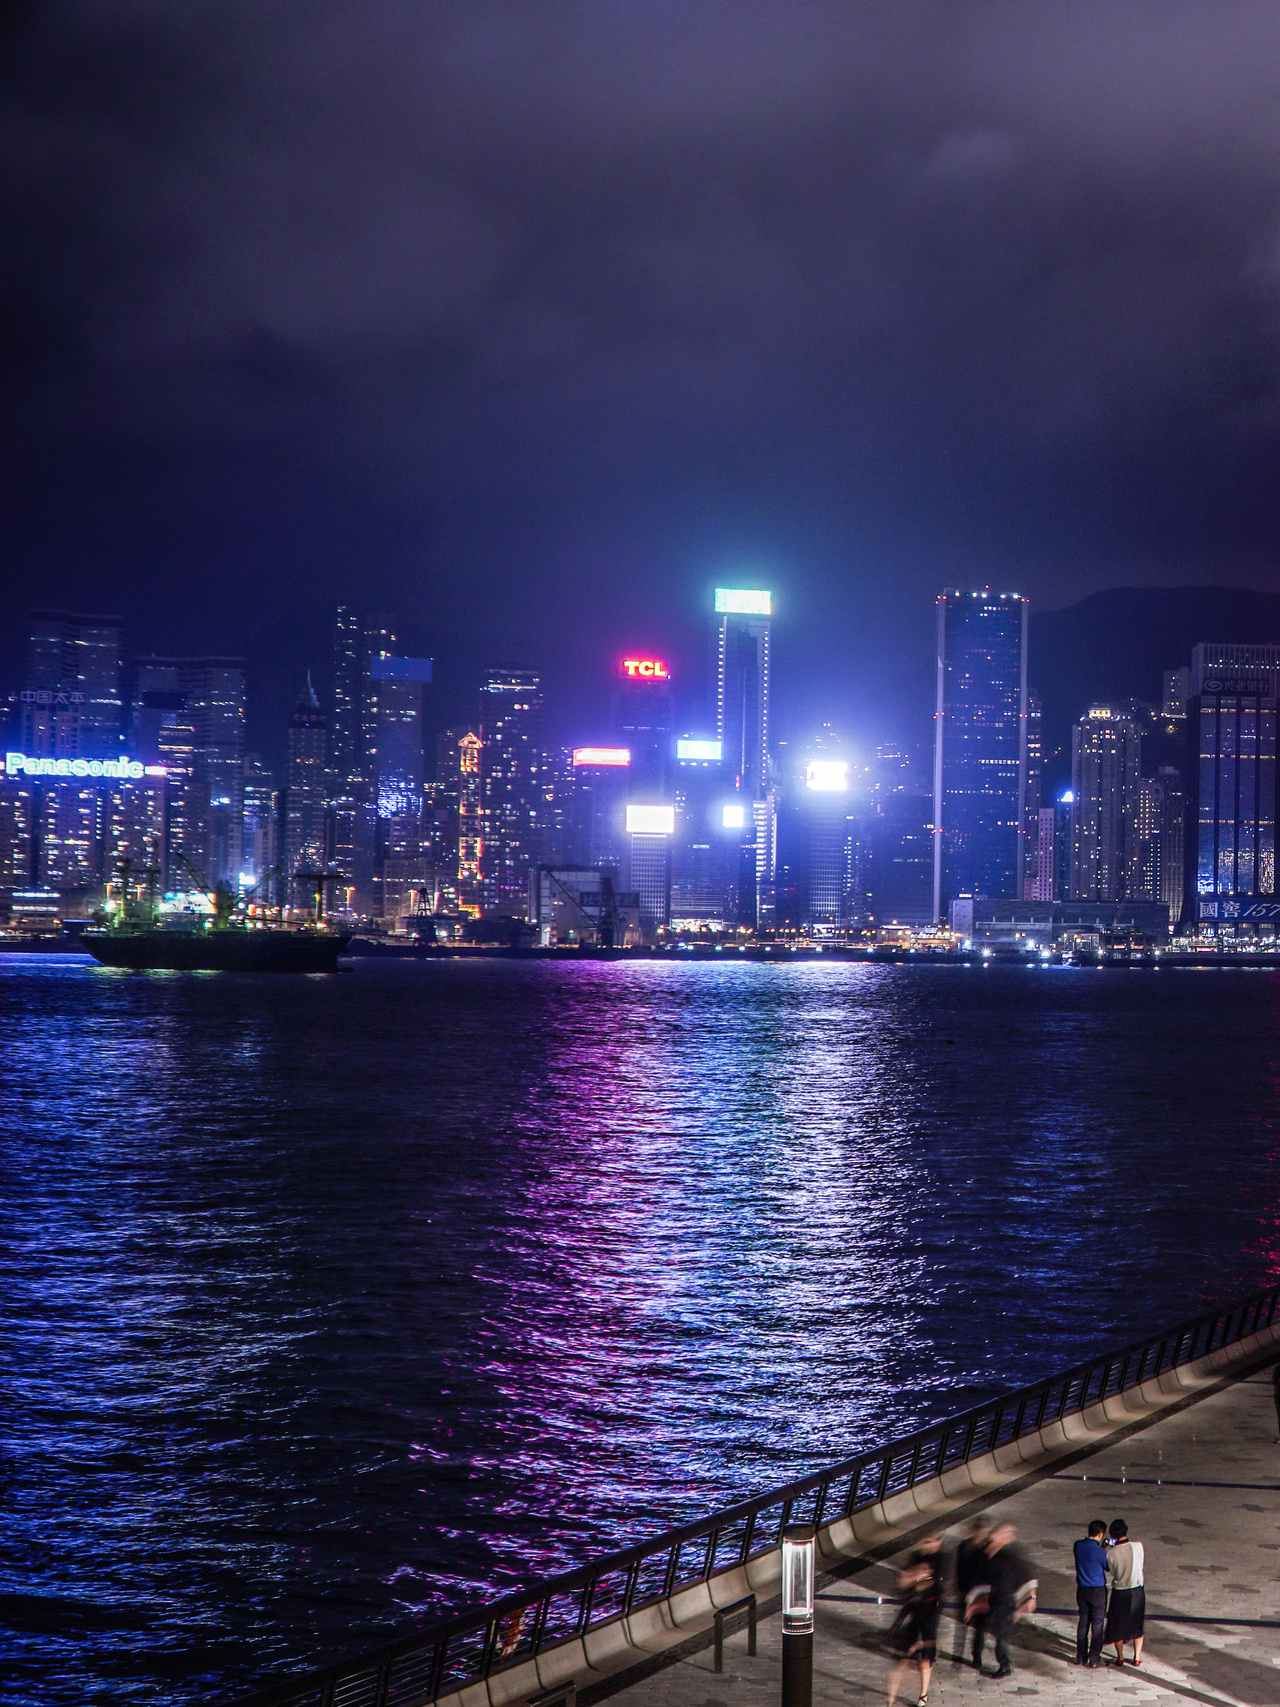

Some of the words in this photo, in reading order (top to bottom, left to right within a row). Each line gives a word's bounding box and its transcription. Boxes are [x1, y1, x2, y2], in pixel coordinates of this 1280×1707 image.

[624, 661, 666, 676] TCL
[20, 689, 86, 704] 中国太平
[5, 752, 145, 778] Panasonic
